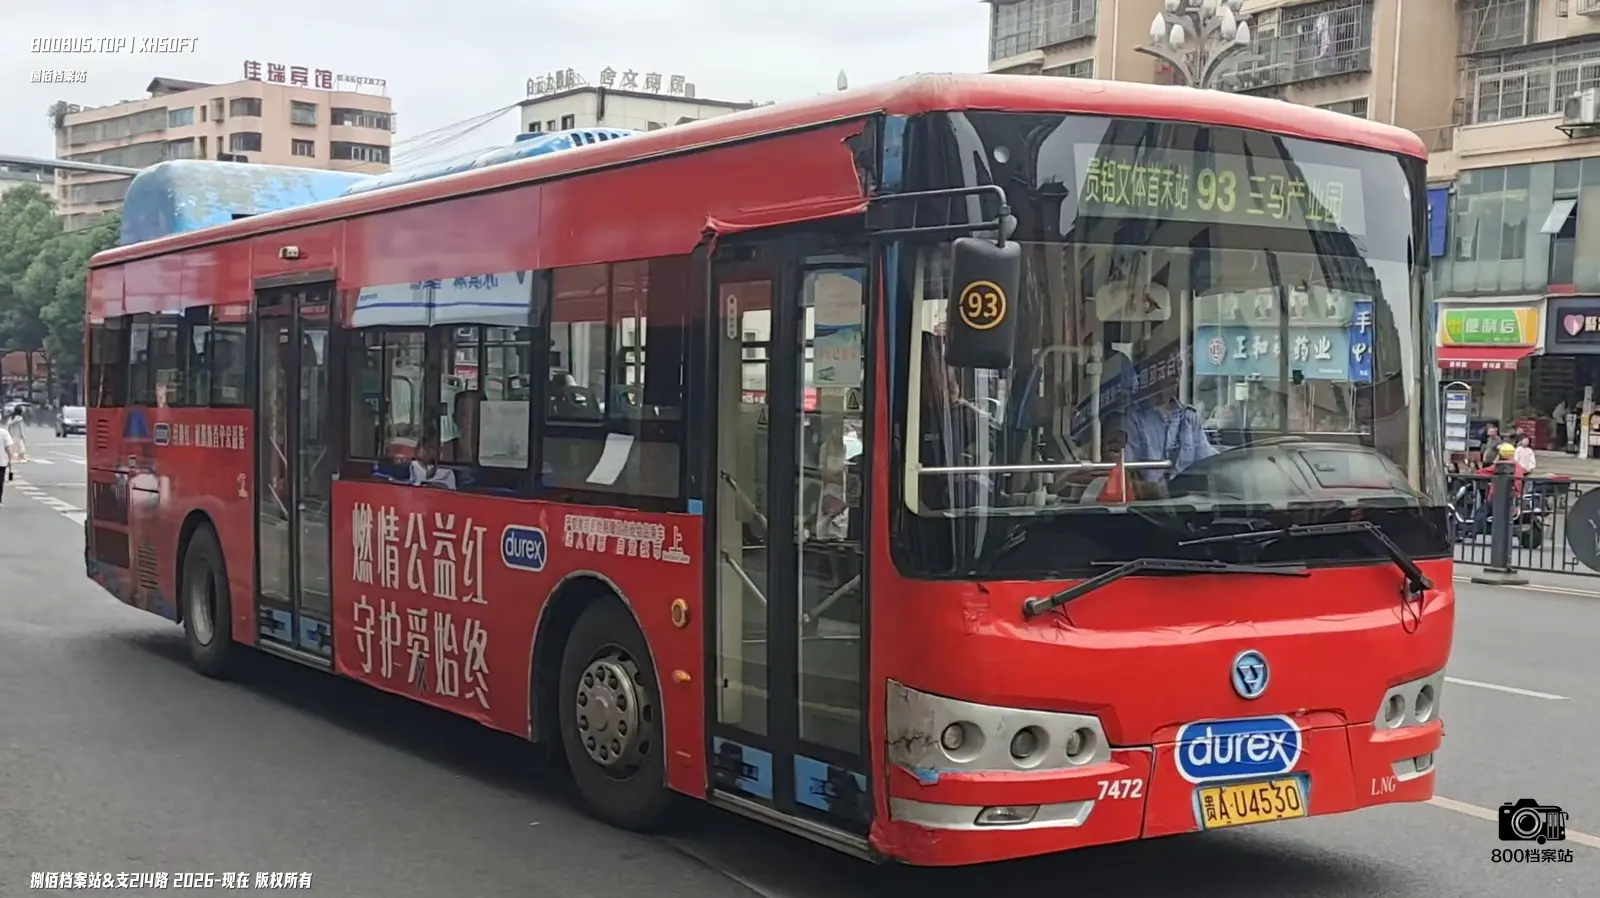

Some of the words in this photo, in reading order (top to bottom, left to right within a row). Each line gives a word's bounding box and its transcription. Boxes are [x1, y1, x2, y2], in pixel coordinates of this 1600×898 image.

[243, 59, 333, 89] 佳瑞宾馆
[1196, 167, 1238, 213] 93
[1246, 174, 1345, 225] 三马产业园
[967, 290, 999, 319] 93
[1465, 317, 1517, 334] 便利店
[351, 501, 489, 605] 燃情公益红
[504, 531, 545, 564] durex
[352, 594, 491, 710] 守护爱始终
[1187, 725, 1291, 768] durex
[1096, 777, 1144, 801] 7472
[1370, 775, 1397, 797] LNG
